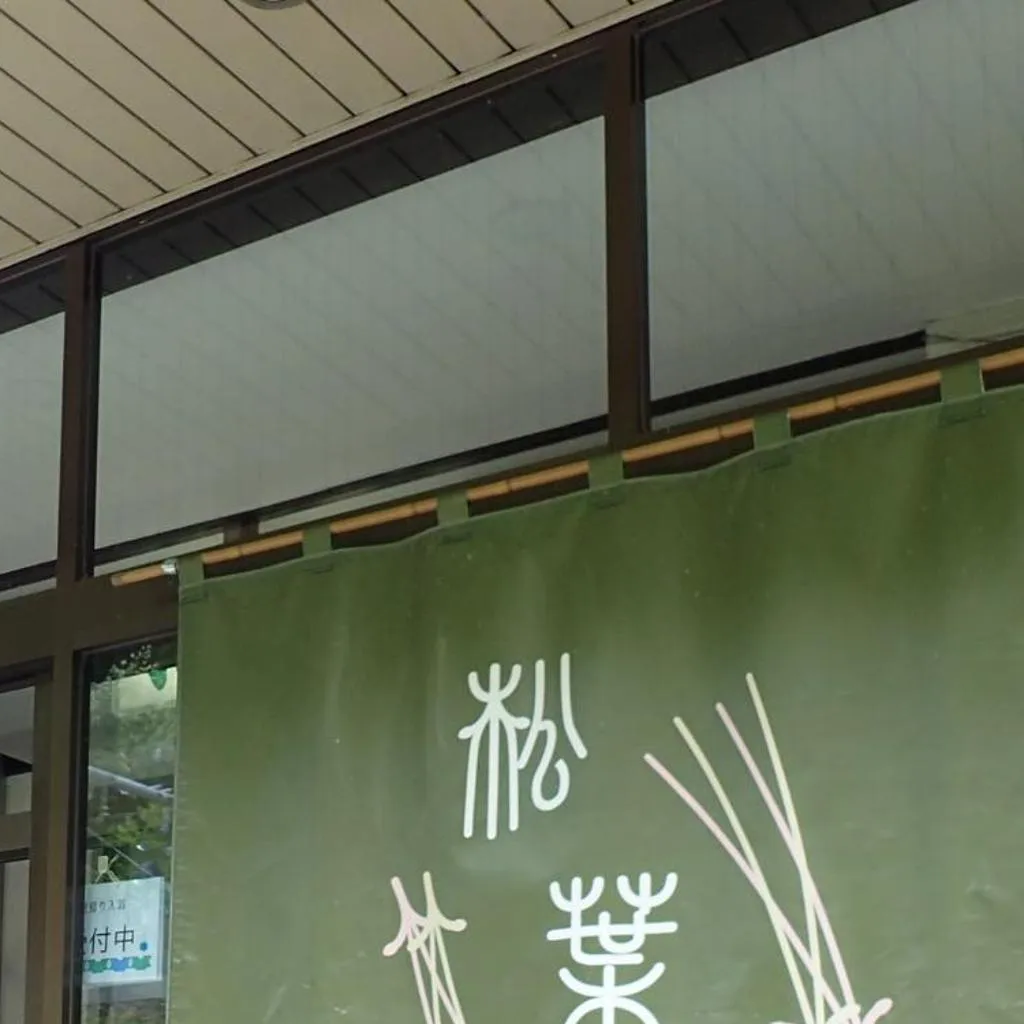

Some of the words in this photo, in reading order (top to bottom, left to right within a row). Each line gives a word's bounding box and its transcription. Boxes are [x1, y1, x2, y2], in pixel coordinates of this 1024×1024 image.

[84, 899, 126, 912] 帰り入浴
[83, 924, 135, 955] 付中
